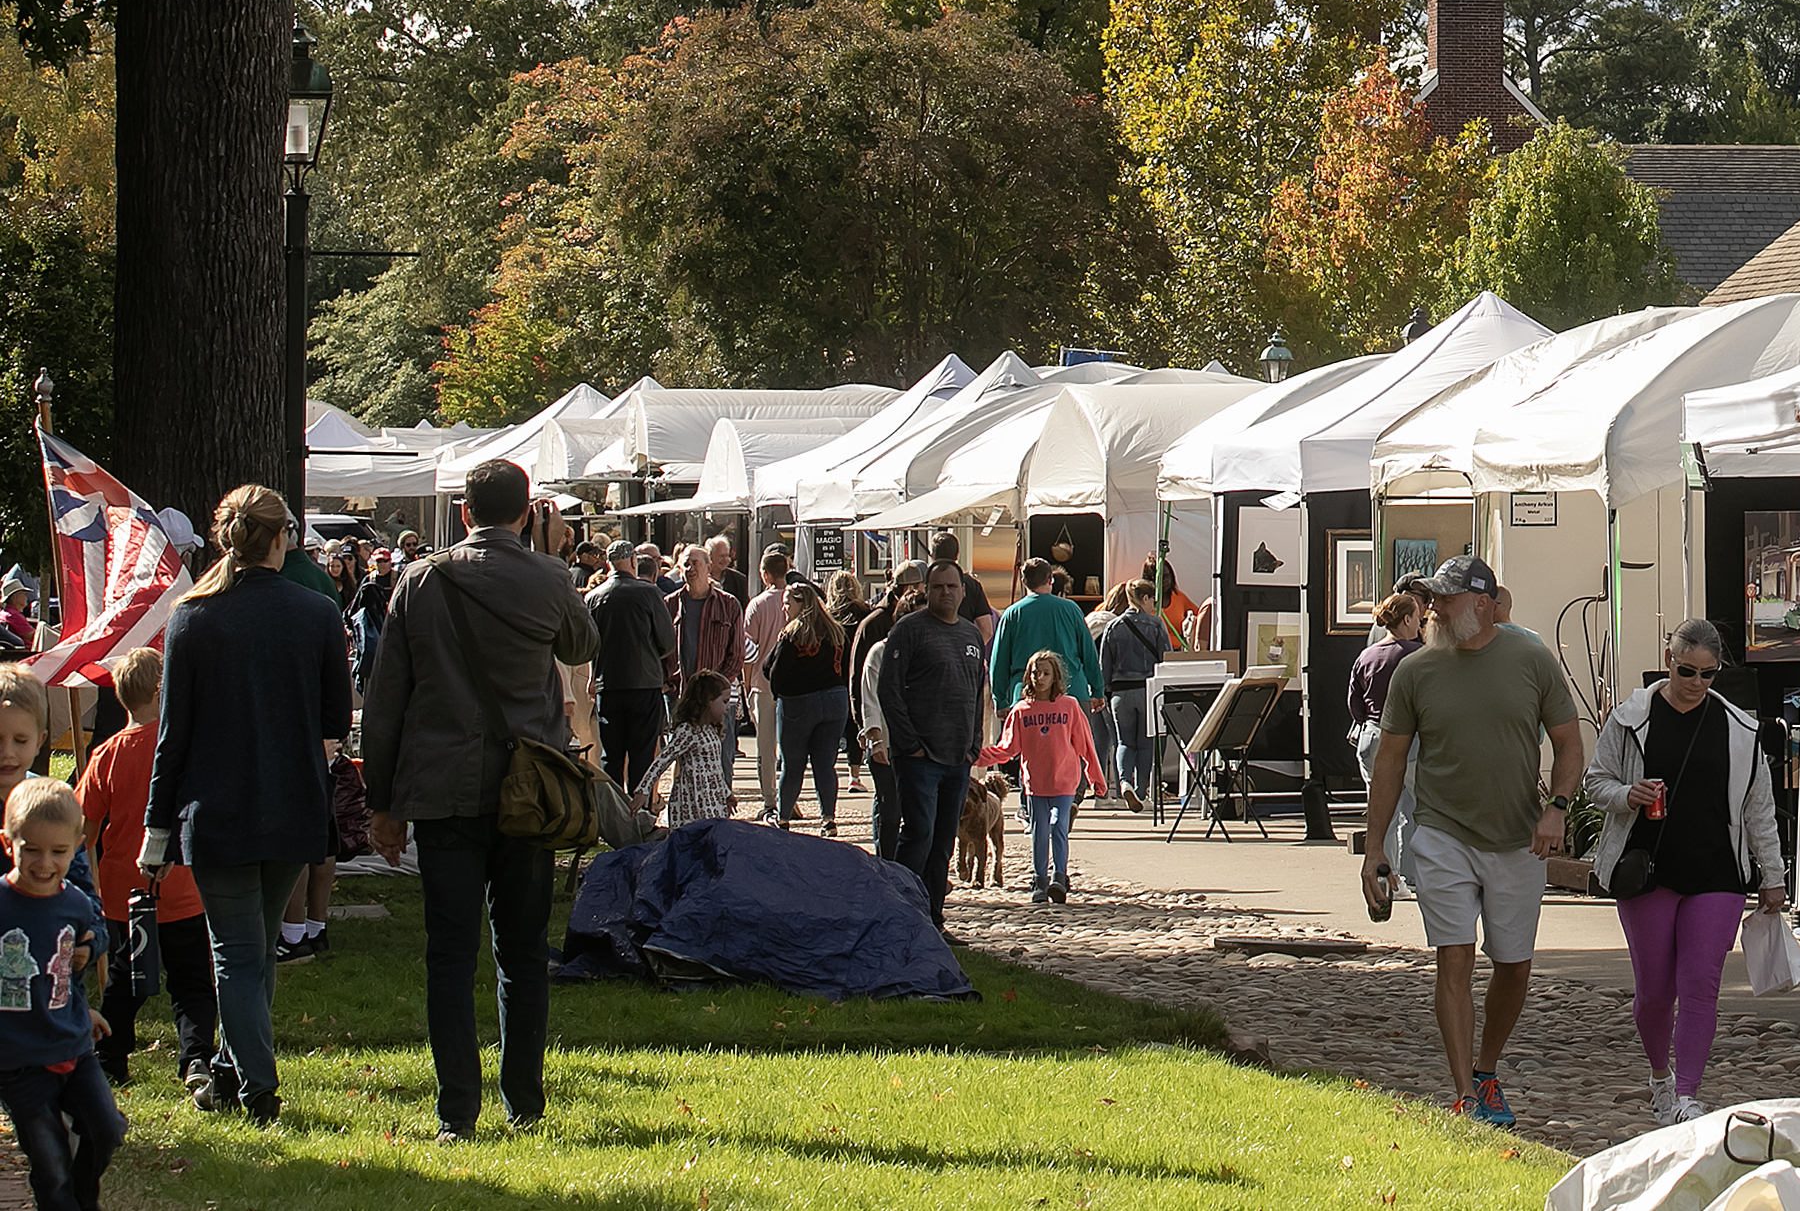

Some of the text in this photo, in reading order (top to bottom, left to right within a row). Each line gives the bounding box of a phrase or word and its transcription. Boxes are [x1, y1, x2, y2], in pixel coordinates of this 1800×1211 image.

[815, 536, 842, 544] MAGIC
[1023, 713, 1068, 727] BALD HEAD
